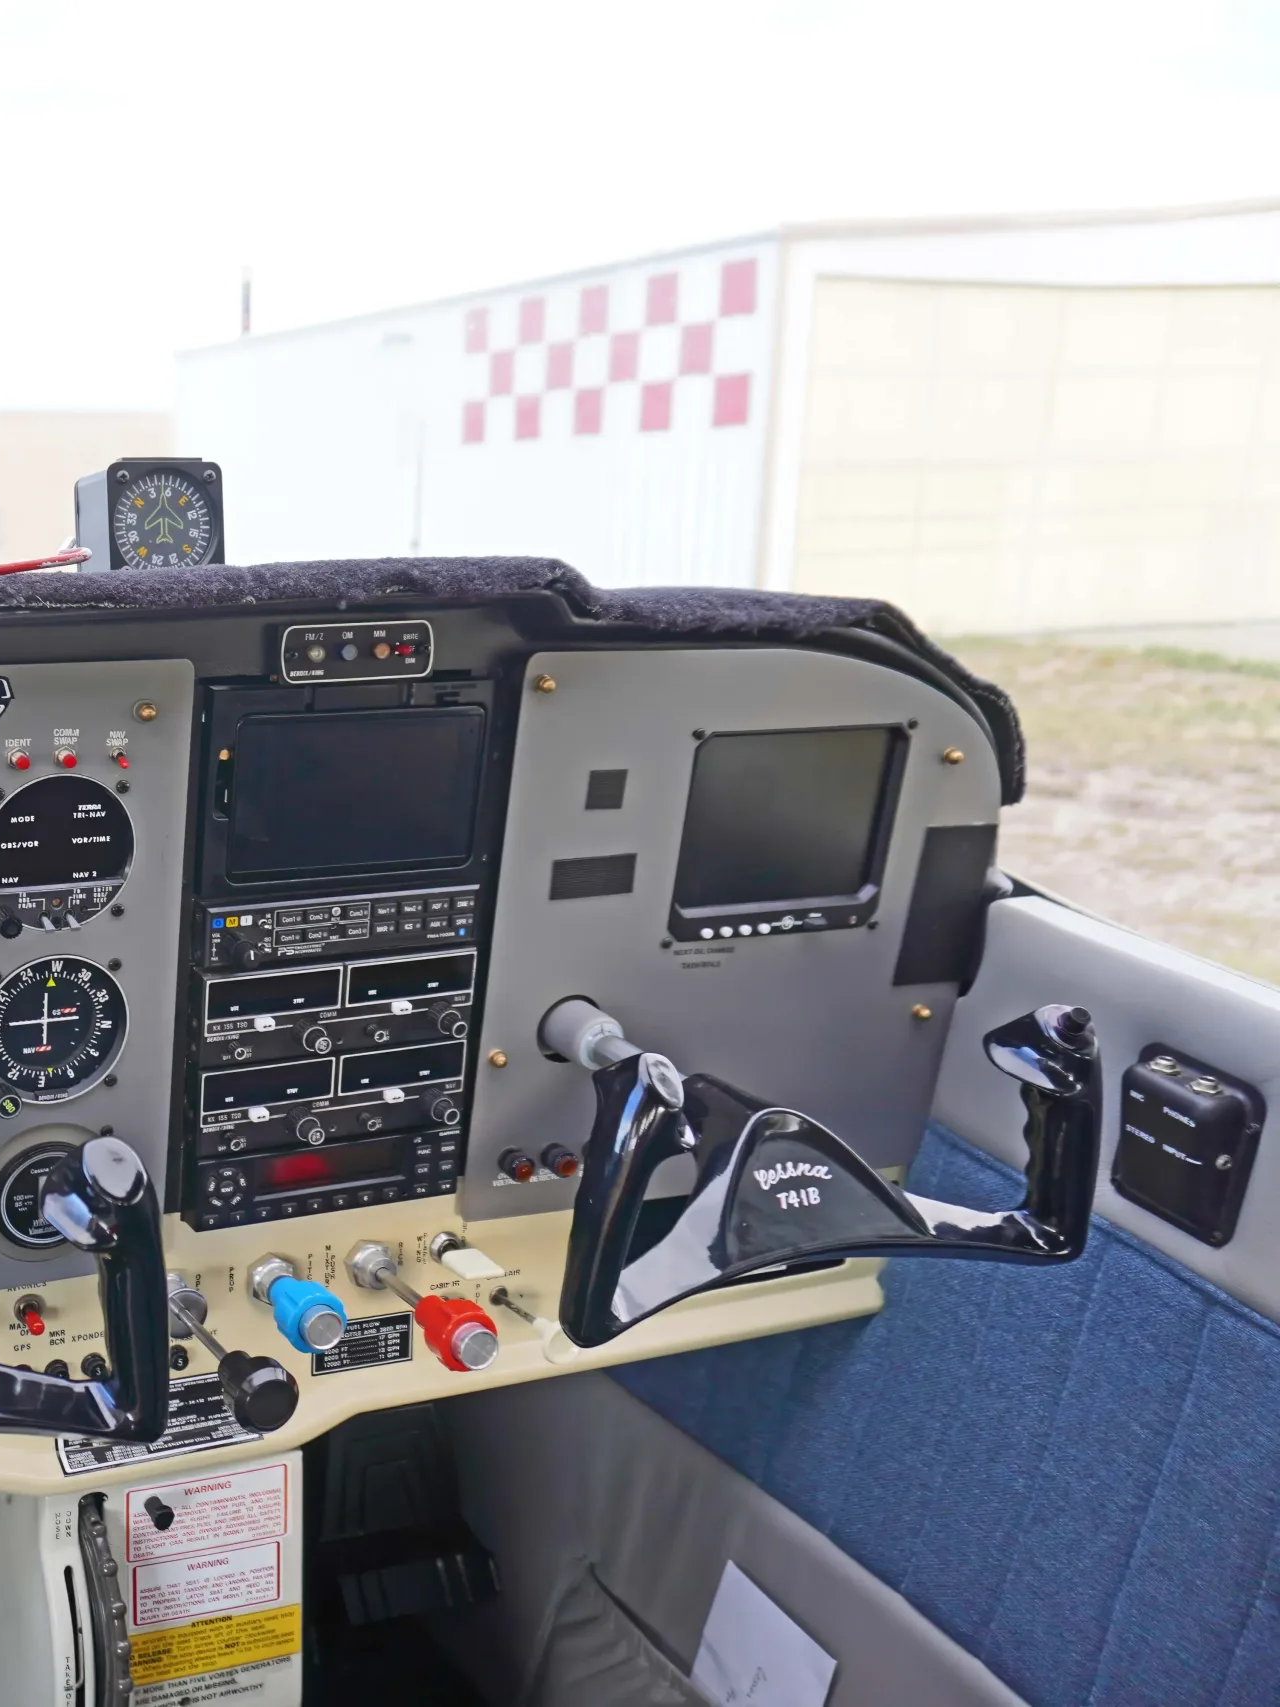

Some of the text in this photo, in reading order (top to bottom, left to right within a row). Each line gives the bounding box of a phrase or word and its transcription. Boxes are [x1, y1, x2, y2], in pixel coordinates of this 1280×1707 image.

[147, 488, 157, 499] 3
[165, 487, 172, 497] 6
[134, 497, 145, 509] N
[178, 495, 189, 507] E
[127, 513, 138, 526] 33
[186, 509, 197, 520] 12
[127, 530, 140, 544] 30
[189, 527, 199, 539] 15
[136, 546, 148, 559] W
[182, 544, 192, 554] S
[151, 553, 164, 566] 24
[168, 552, 179, 565] 21
[342, 631, 354, 639] OM
[373, 630, 386, 638] MM
[402, 633, 419, 641] BRITE
[53, 728, 80, 737] COMM
[109, 730, 126, 739] NAV
[5, 738, 32, 748] IDENT
[53, 736, 78, 746] SWAP
[106, 738, 129, 746] SWAP
[10, 815, 35, 824] MODE
[72, 811, 106, 819] TRI-NAV
[0, 840, 39, 850] OBS/VOR
[71, 835, 111, 845] VOR/TIME
[72, 871, 90, 879] NAV
[309, 913, 323, 921] Com2
[51, 961, 64, 972] W
[20, 968, 34, 981] 24
[78, 968, 92, 982] 30
[96, 989, 109, 1003] 33
[319, 1011, 338, 1019] COMM
[100, 1020, 113, 1029] N
[89, 1049, 100, 1057] 3
[7, 1067, 20, 1081] 12
[37, 1076, 46, 1088] E
[2, 1099, 16, 1114] OBS
[753, 1161, 832, 1191] Cessna
[776, 1186, 821, 1210] T41B
[49, 1329, 66, 1338] MKR
[49, 1337, 66, 1346] BCN
[13, 1343, 31, 1352] GPS
[183, 1481, 232, 1496] WARNING
[187, 1557, 229, 1572] WARNING
[190, 1615, 233, 1629] ATTENTION
[224, 1641, 241, 1650] NOT
[167, 1679, 188, 1689] THAN
[189, 1675, 206, 1685] FIVE
[151, 1688, 190, 1703] DAMAGED
[200, 1682, 265, 1702] NOT AIRWORTHY
